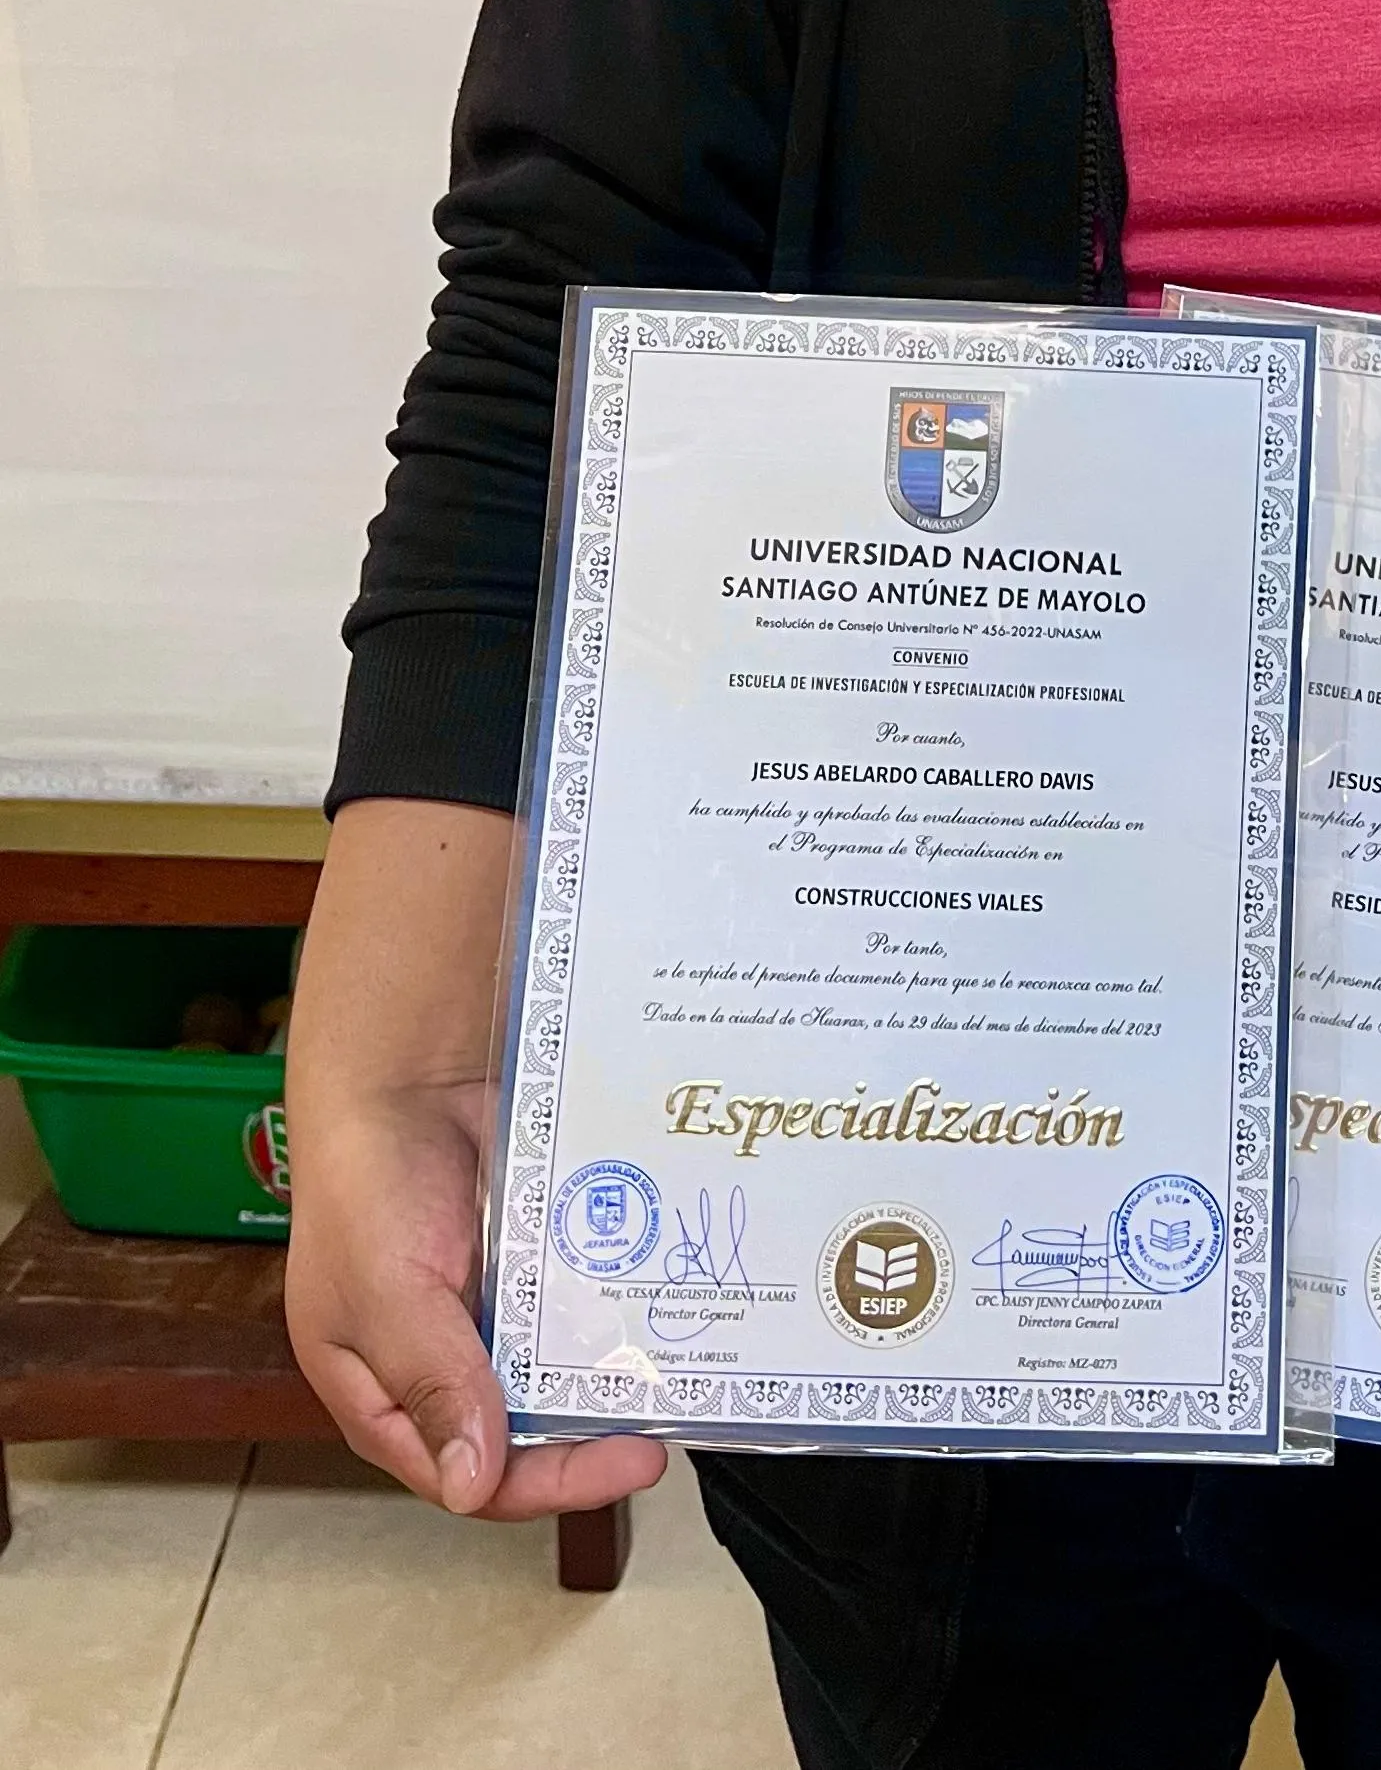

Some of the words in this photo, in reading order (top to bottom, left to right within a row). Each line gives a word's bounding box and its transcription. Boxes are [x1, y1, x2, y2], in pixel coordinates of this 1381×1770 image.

[916, 516, 965, 531] UNASAM
[750, 537, 951, 569] UNIVERSIDAD
[962, 546, 1122, 576] NACIONAL
[721, 575, 858, 603] SANTIAGO
[866, 577, 989, 608] ANTÚNEZ
[997, 586, 1030, 610] DE
[1036, 588, 1146, 615] MAYOLO
[755, 616, 815, 629] Resolución
[818, 618, 834, 631] de
[837, 618, 884, 634] Consejo
[887, 620, 959, 635] Universitario
[981, 624, 1102, 640] 456-2022-UNASAM
[893, 650, 969, 665] CONVENIO
[728, 673, 785, 689] ESCUELA
[790, 675, 807, 690] DE
[810, 676, 908, 694] INVESTIGACIÓN
[912, 680, 921, 694] Y
[924, 680, 1035, 699] ESPECIALIZACIÓN
[1039, 685, 1125, 703] PROFESIONAL
[1306, 678, 1362, 702] ESCUELA
[875, 720, 910, 743] Por
[912, 730, 965, 748] cuanto,
[750, 761, 808, 782] JESUS
[813, 763, 917, 785] ABELARDO
[923, 767, 1033, 789] CABALLERO
[1039, 771, 1094, 791] DAVIS
[688, 799, 712, 816] ha
[715, 801, 793, 824] cumplido
[793, 809, 809, 828] y
[813, 804, 891, 827] aprobado
[894, 805, 919, 823] las
[922, 806, 1025, 827] evaluaciones
[1029, 809, 1121, 830] establecidas
[1125, 821, 1144, 831] en
[768, 832, 789, 851] el
[790, 831, 884, 861] Programa
[888, 837, 908, 856] de
[915, 834, 1040, 864] Especialización
[1043, 851, 1064, 861] en
[1340, 842, 1361, 860] el
[794, 886, 972, 910] CONSTRUCCIONES
[977, 892, 1044, 913] VIALES
[864, 931, 901, 955] Por
[903, 939, 948, 958] tanto,
[652, 967, 668, 978] se
[670, 959, 685, 979] le
[740, 962, 760, 981] el
[752, 966, 821, 990] presente
[824, 964, 907, 986] documento
[904, 970, 948, 994] para
[951, 977, 979, 995] que
[981, 977, 996, 989] se
[999, 970, 1014, 989] le
[1094, 981, 1134, 993] como
[642, 1001, 687, 1022] Dado
[689, 1013, 707, 1023] en
[709, 1005, 725, 1023] la
[728, 1006, 780, 1025] ciudad
[778, 1007, 796, 1026] de
[873, 1019, 883, 1028] a
[886, 1010, 905, 1029] los
[907, 1014, 928, 1030] 29
[960, 1014, 987, 1031] del
[985, 1022, 1011, 1032] mes
[1013, 1015, 1030, 1033] de
[1032, 1016, 1098, 1035] diciembre
[1100, 1017, 1127, 1035] del
[1124, 1021, 1162, 1037] 2023
[665, 1077, 1125, 1156] Especialización
[583, 1238, 630, 1249] JEFATURA
[626, 1286, 664, 1303] CESAR
[662, 1286, 720, 1301] AUGUSTO
[758, 1290, 796, 1302] LAMAS
[860, 1297, 908, 1315] ESIEP
[1001, 1293, 1035, 1308] DAISY
[1034, 1296, 1070, 1310] JENNY
[1121, 1298, 1162, 1310] ZAPATA
[648, 1306, 697, 1321] Director
[699, 1307, 745, 1322] General
[1017, 1314, 1072, 1328] Directora
[1074, 1316, 1120, 1330] General
[1017, 1356, 1066, 1372] Registro:
